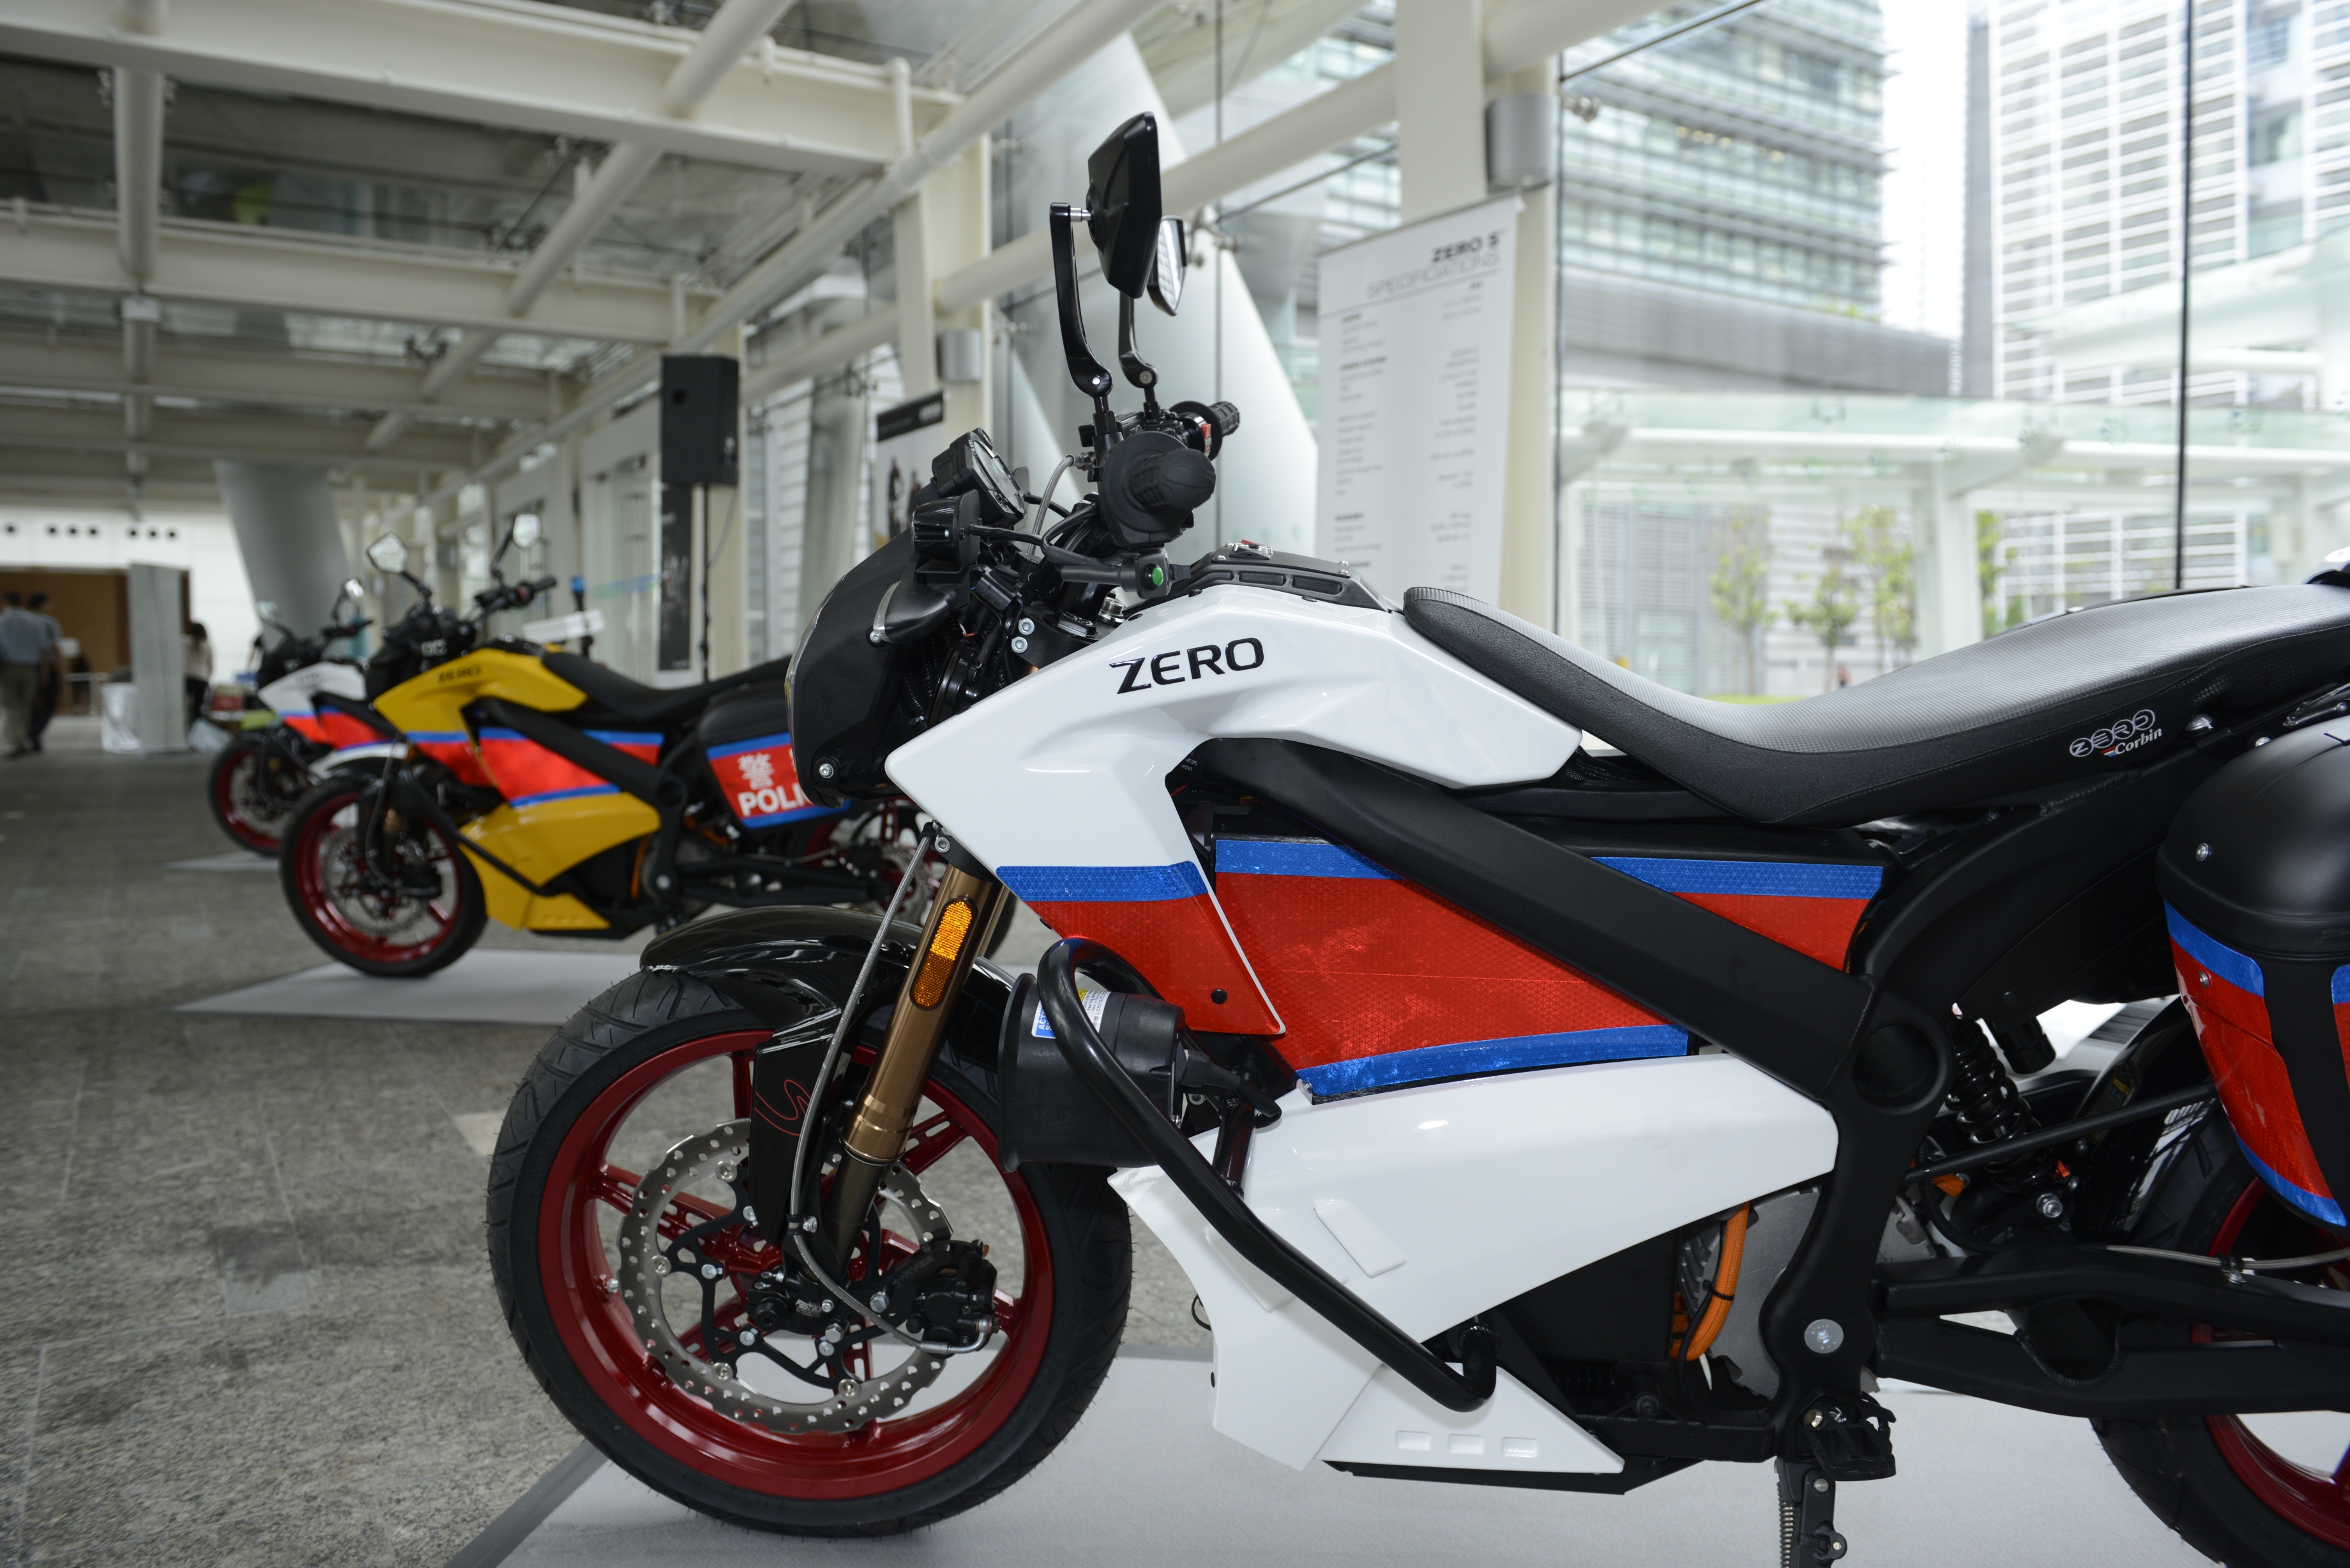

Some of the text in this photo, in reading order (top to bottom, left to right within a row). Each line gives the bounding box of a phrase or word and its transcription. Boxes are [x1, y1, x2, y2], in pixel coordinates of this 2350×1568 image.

[1431, 236, 1483, 263] ZERO
[1109, 637, 1264, 695] ZERO
[2114, 728, 2163, 755] Corbin
[737, 782, 808, 817] POLI
[851, 979, 861, 993] SAE
[873, 928, 883, 942] DOT
